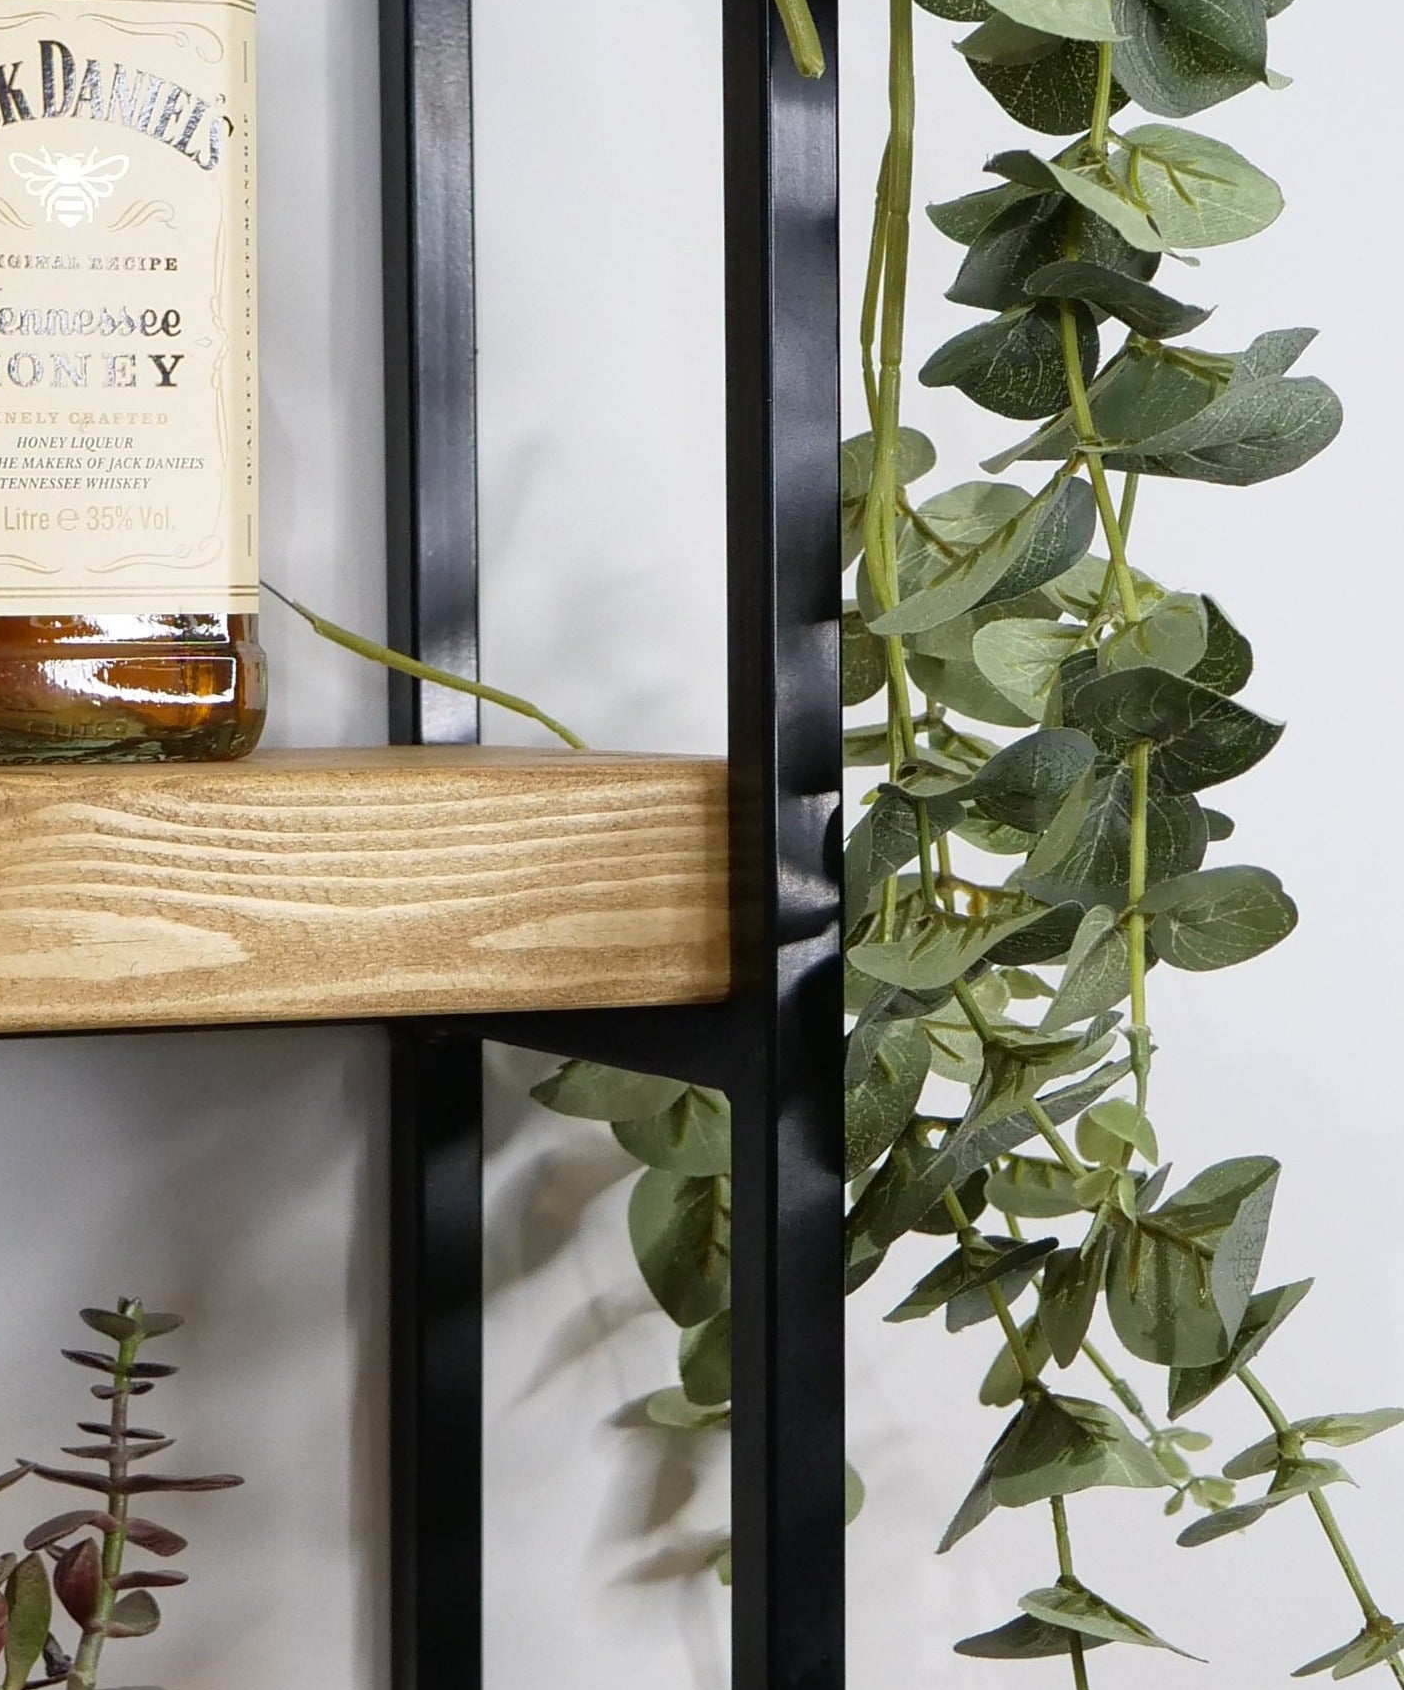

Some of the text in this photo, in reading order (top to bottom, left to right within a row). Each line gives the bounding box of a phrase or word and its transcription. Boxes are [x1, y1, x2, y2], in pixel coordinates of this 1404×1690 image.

[37, 39, 234, 171] DANIEL'S
[88, 256, 179, 271] RECIPE
[68, 412, 169, 426] CRAFTED
[16, 436, 135, 452] HONEY LIQUEUR
[21, 457, 83, 470] MAKERS
[86, 457, 108, 470] OF
[106, 457, 144, 473] JACK
[85, 477, 152, 490] WHISKEY
[3, 506, 50, 531] Litre
[86, 505, 134, 531] 35%
[138, 505, 177, 531] Vol.
